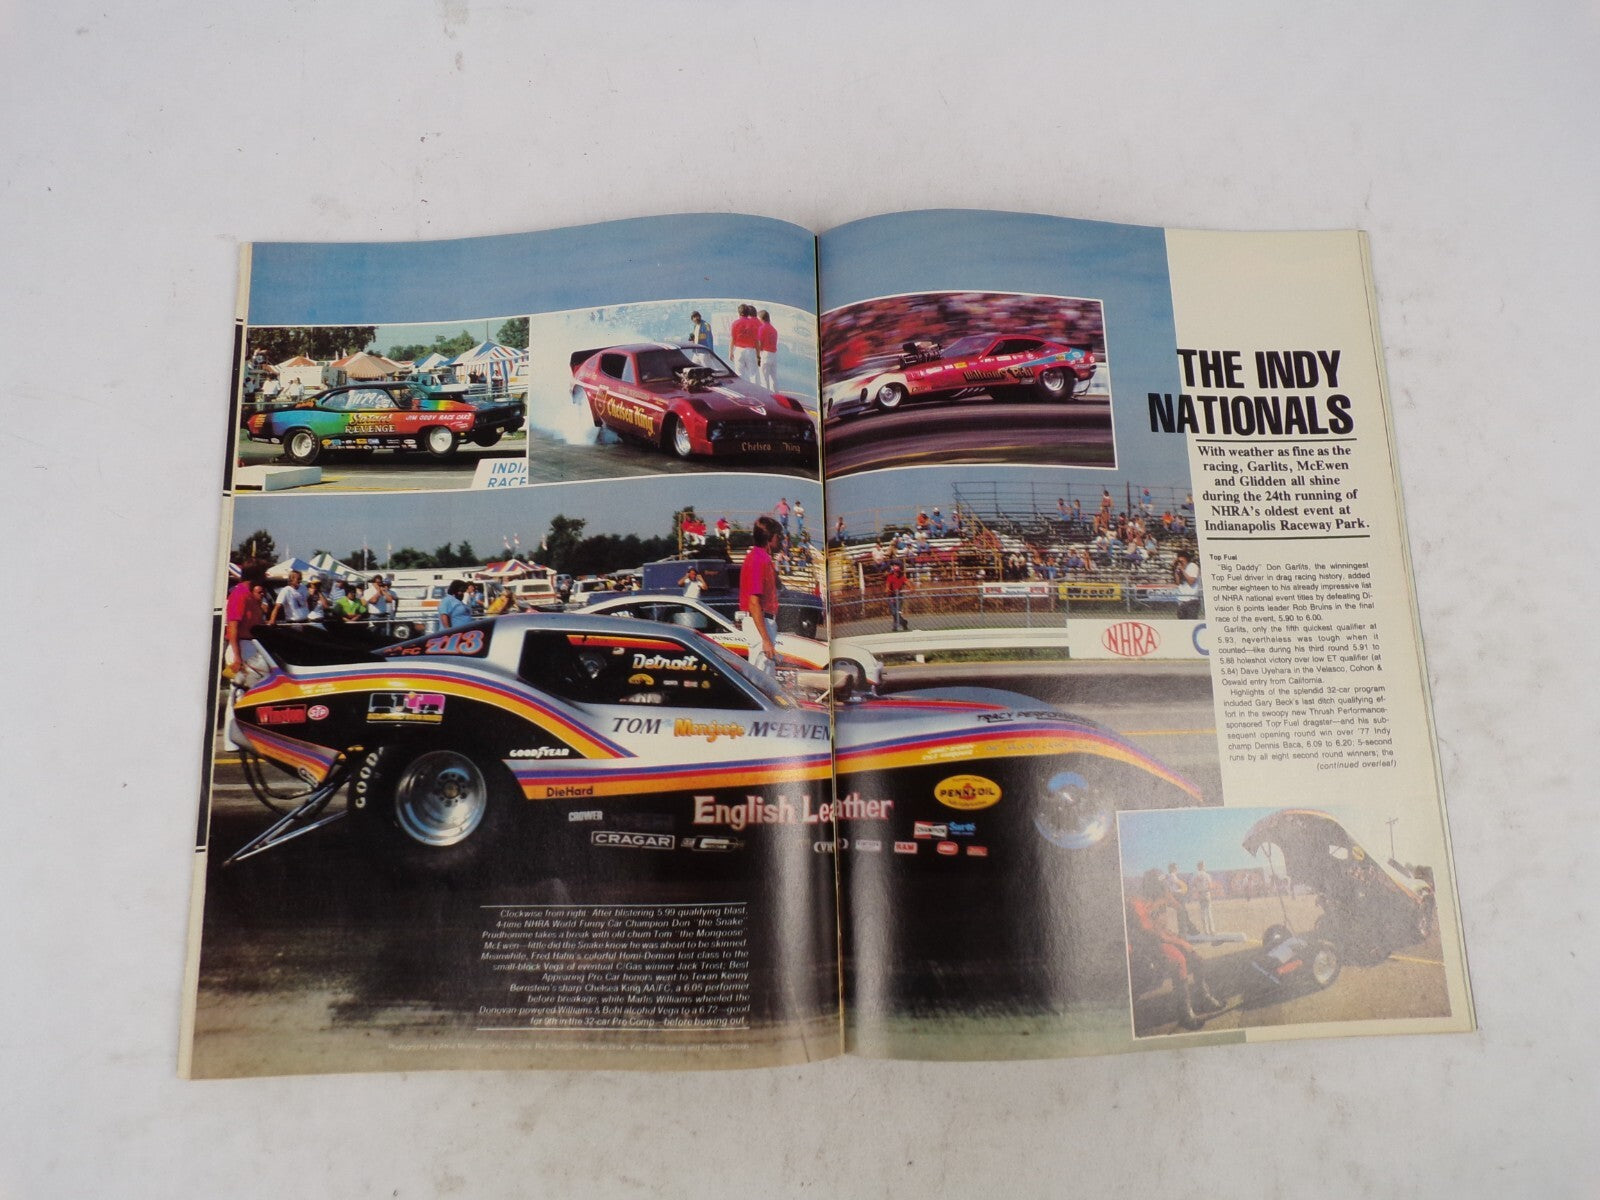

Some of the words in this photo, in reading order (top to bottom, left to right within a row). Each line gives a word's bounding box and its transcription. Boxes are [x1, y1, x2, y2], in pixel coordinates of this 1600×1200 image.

[1177, 349, 1244, 388] THE
[1255, 350, 1341, 388] INDY
[607, 398, 633, 424] Chelsea
[633, 405, 655, 436] King
[1148, 393, 1354, 436] NATIONALS
[345, 425, 395, 434] REVENGE
[1197, 446, 1225, 456] With
[1228, 446, 1274, 456] weather
[1292, 446, 1314, 455] fine
[1332, 445, 1351, 454] the
[1203, 462, 1242, 473] racing,
[1246, 460, 1292, 472] Garlits,
[1296, 460, 1348, 470] McEwen
[1214, 476, 1235, 486] and
[1239, 475, 1286, 486] Glidden
[1290, 475, 1304, 485] all
[1309, 475, 1340, 484] shine
[1202, 490, 1239, 504] during
[1243, 491, 1261, 501] the
[1264, 490, 1290, 500] 24th
[1294, 491, 1342, 502] running
[1345, 488, 1358, 498] of
[1211, 505, 1260, 516] NHRA's
[1264, 505, 1298, 515] oldest
[1303, 506, 1333, 515] event
[1338, 505, 1350, 514] at
[1204, 519, 1275, 533] Indianapolis
[1279, 519, 1331, 532] Raceway
[1335, 518, 1369, 528] Park.
[1329, 562, 1368, 570] winningest
[1211, 573, 1224, 581] Top
[1275, 574, 1292, 582] drag
[1302, 624, 1332, 632] quickest
[1336, 623, 1365, 631] qualifier
[1106, 622, 1158, 656] NHRA
[632, 654, 699, 670] Detroit
[1249, 678, 1267, 686] entry
[1230, 688, 1264, 697] Highlights
[1293, 687, 1323, 695] splendid
[1254, 698, 1272, 707] Gary
[1337, 696, 1373, 704] qualifying
[612, 717, 662, 734] TOM
[674, 718, 746, 742] Mongoose
[1227, 742, 1251, 751] champ
[1254, 741, 1279, 749] Dennis
[1282, 740, 1303, 748] Baca,
[509, 746, 570, 758] GOODYEAR
[1316, 761, 1359, 769] (continued
[1361, 759, 1397, 768] overleaf)
[546, 786, 594, 798] DieHard
[940, 787, 996, 798] PENNZOIL
[568, 811, 603, 822] CROWER
[694, 796, 796, 830] English
[802, 792, 894, 824] Leather
[595, 834, 671, 847] CRAGAR
